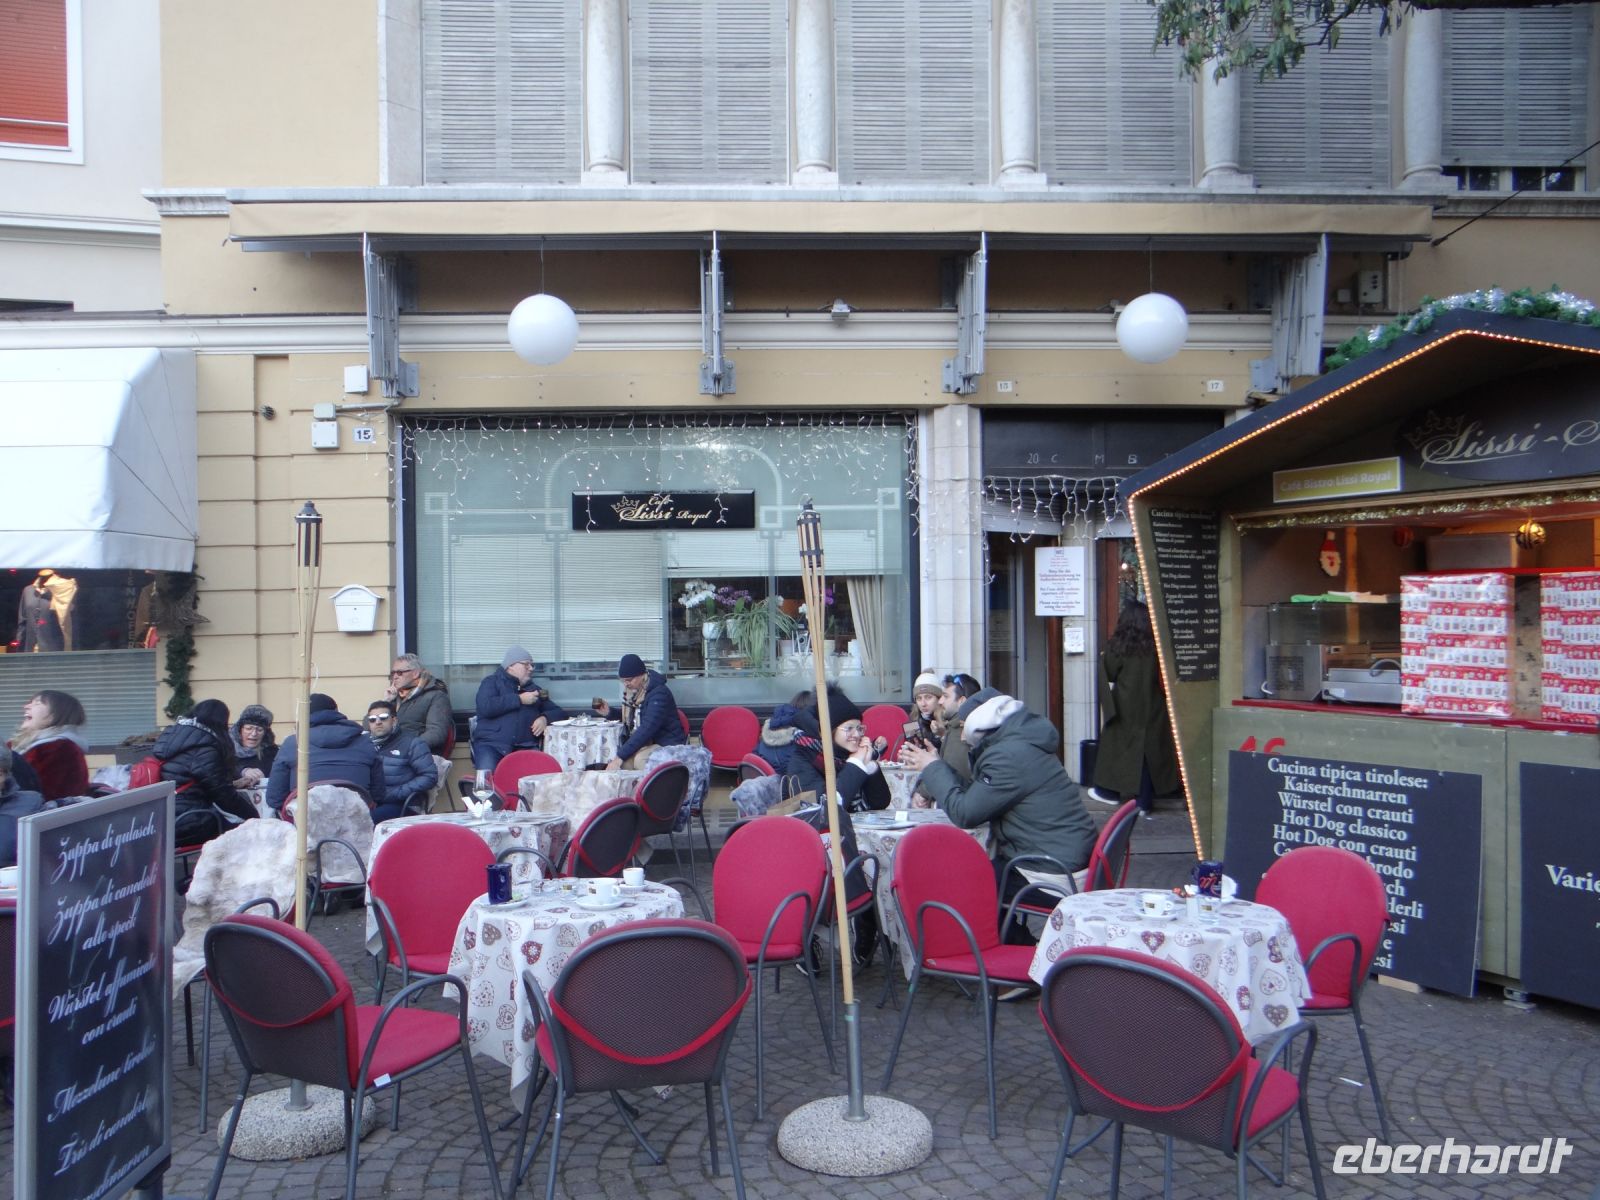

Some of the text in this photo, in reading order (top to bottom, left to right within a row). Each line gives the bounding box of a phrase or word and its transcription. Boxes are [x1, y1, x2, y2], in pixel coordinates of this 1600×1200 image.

[1210, 382, 1220, 390] 17
[356, 429, 371, 440] 15
[1027, 453, 1039, 464] 20
[1304, 478, 1333, 489] Bistro
[1360, 470, 1392, 484] Royal
[676, 510, 712, 525] Royal
[1268, 757, 1429, 789] Cucina tipica tirolese:
[1284, 775, 1408, 804] Kaiserschmarren
[1277, 791, 1414, 824] Würstel con crauti
[101, 823, 114, 850] di
[1282, 808, 1408, 841] Hot Dog classico
[1273, 824, 1417, 861] Hot Dog con crauti
[1366, 856, 1414, 879] brodo
[101, 877, 114, 906] di
[82, 995, 138, 1045] con crauti
[54, 1131, 88, 1177] Tris
[88, 1119, 105, 1151] di
